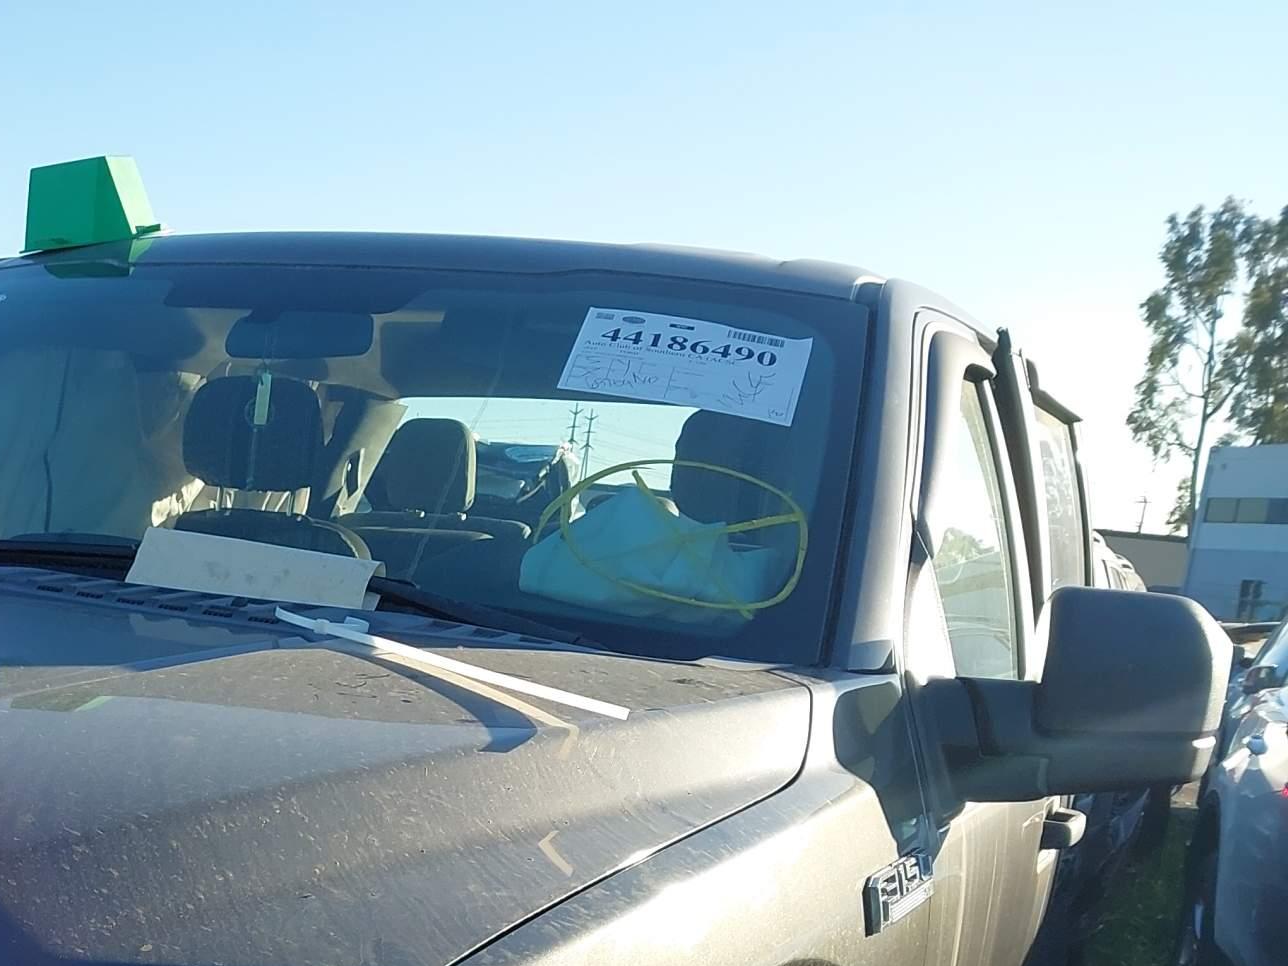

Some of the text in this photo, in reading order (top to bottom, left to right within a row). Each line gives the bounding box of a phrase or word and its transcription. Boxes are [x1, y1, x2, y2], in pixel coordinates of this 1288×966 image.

[584, 339, 606, 347] Auto
[608, 341, 631, 350] Club
[600, 326, 778, 367] 44186490
